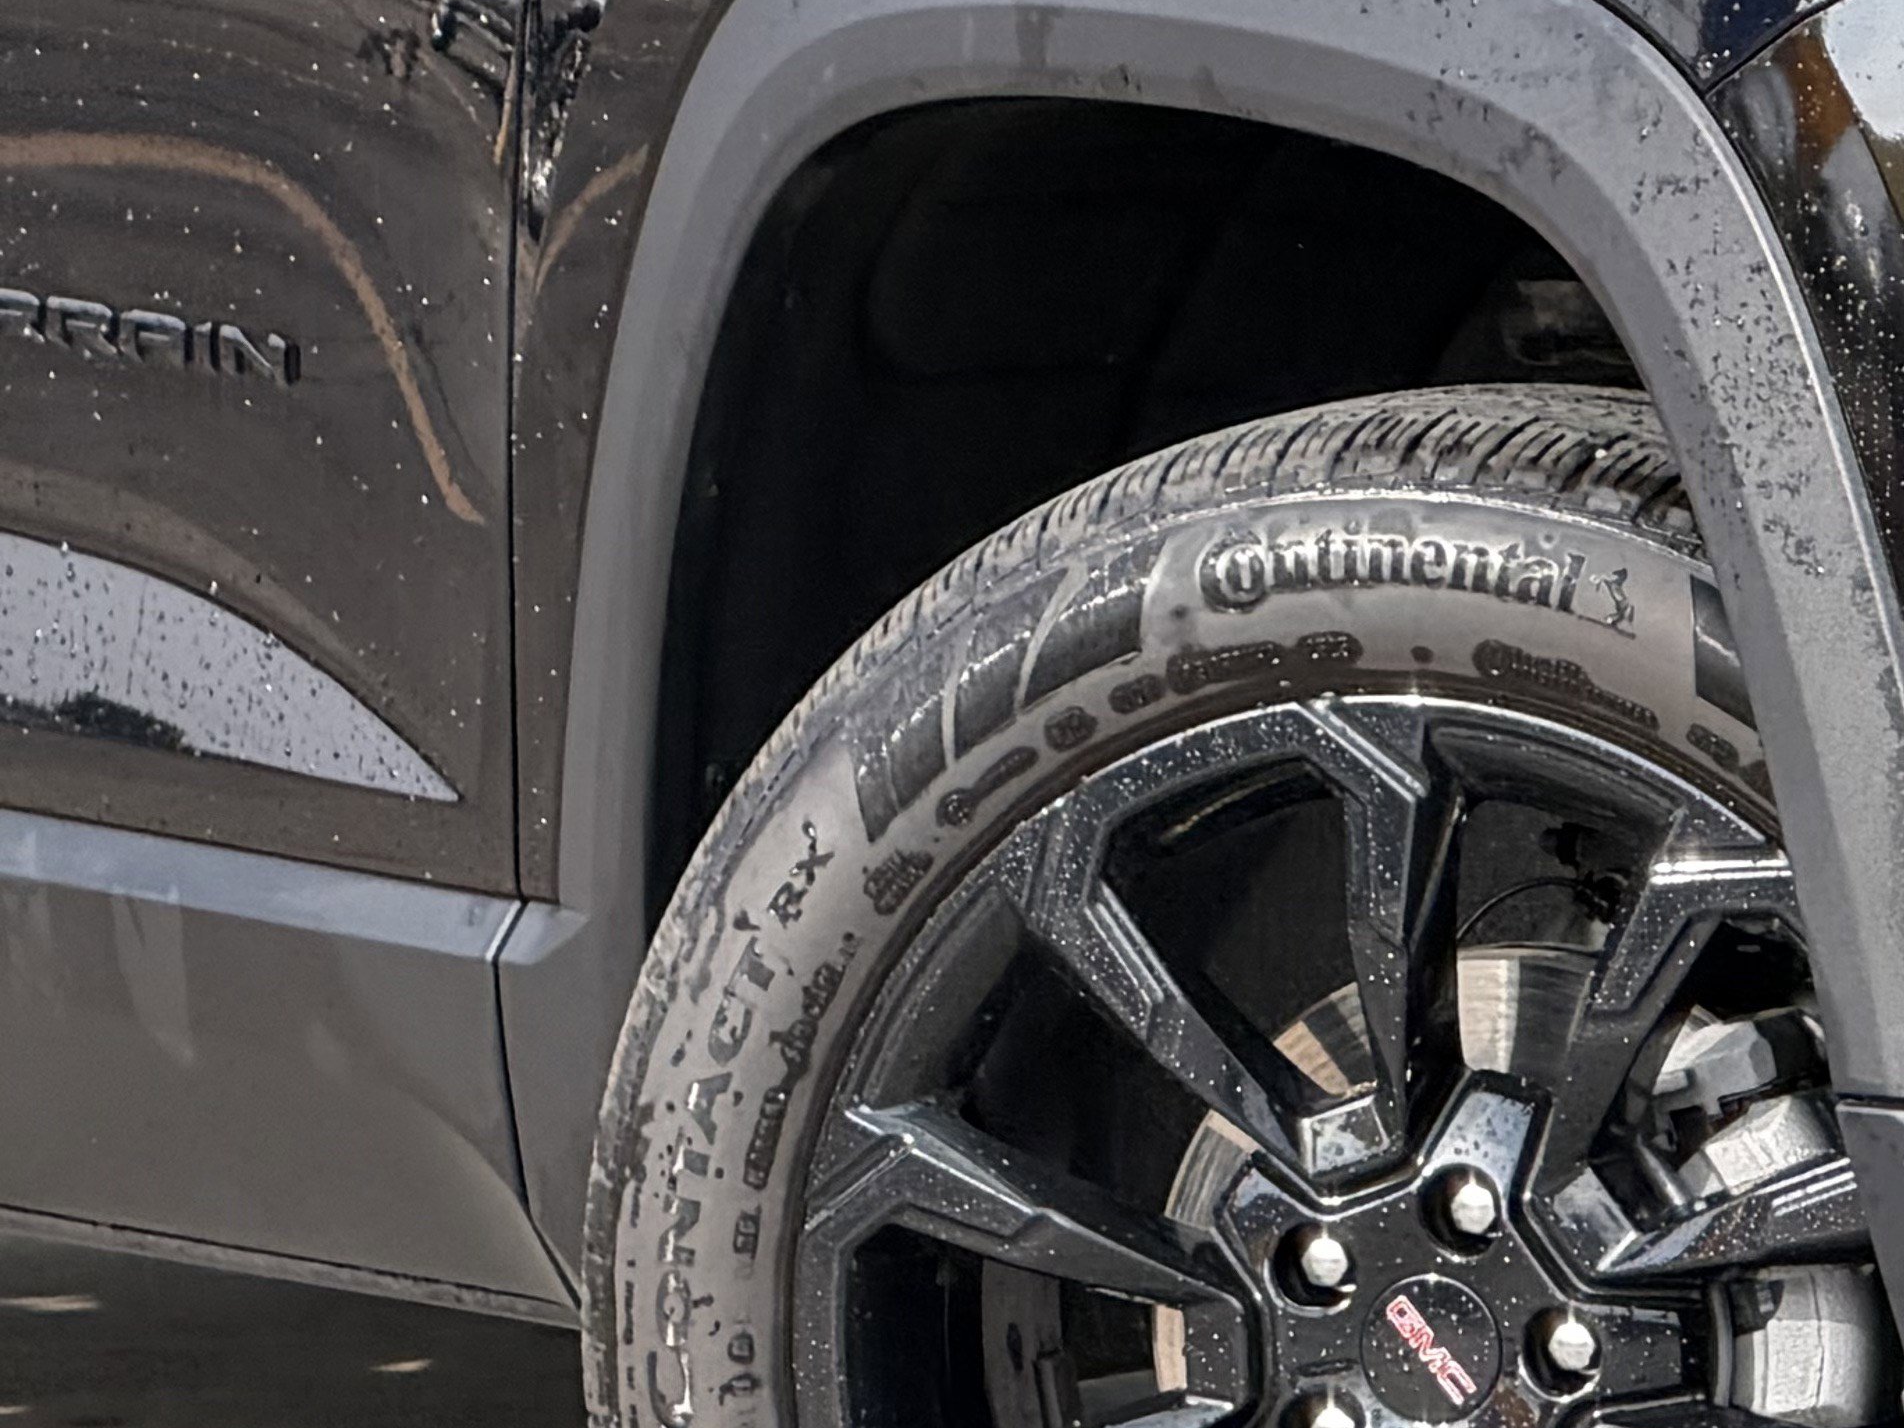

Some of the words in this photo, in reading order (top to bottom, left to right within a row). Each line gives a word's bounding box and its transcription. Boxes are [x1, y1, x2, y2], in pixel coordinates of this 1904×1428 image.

[1197, 520, 1586, 613] Continental
[766, 832, 835, 928] RX
[1385, 1293, 1478, 1406] GMC
